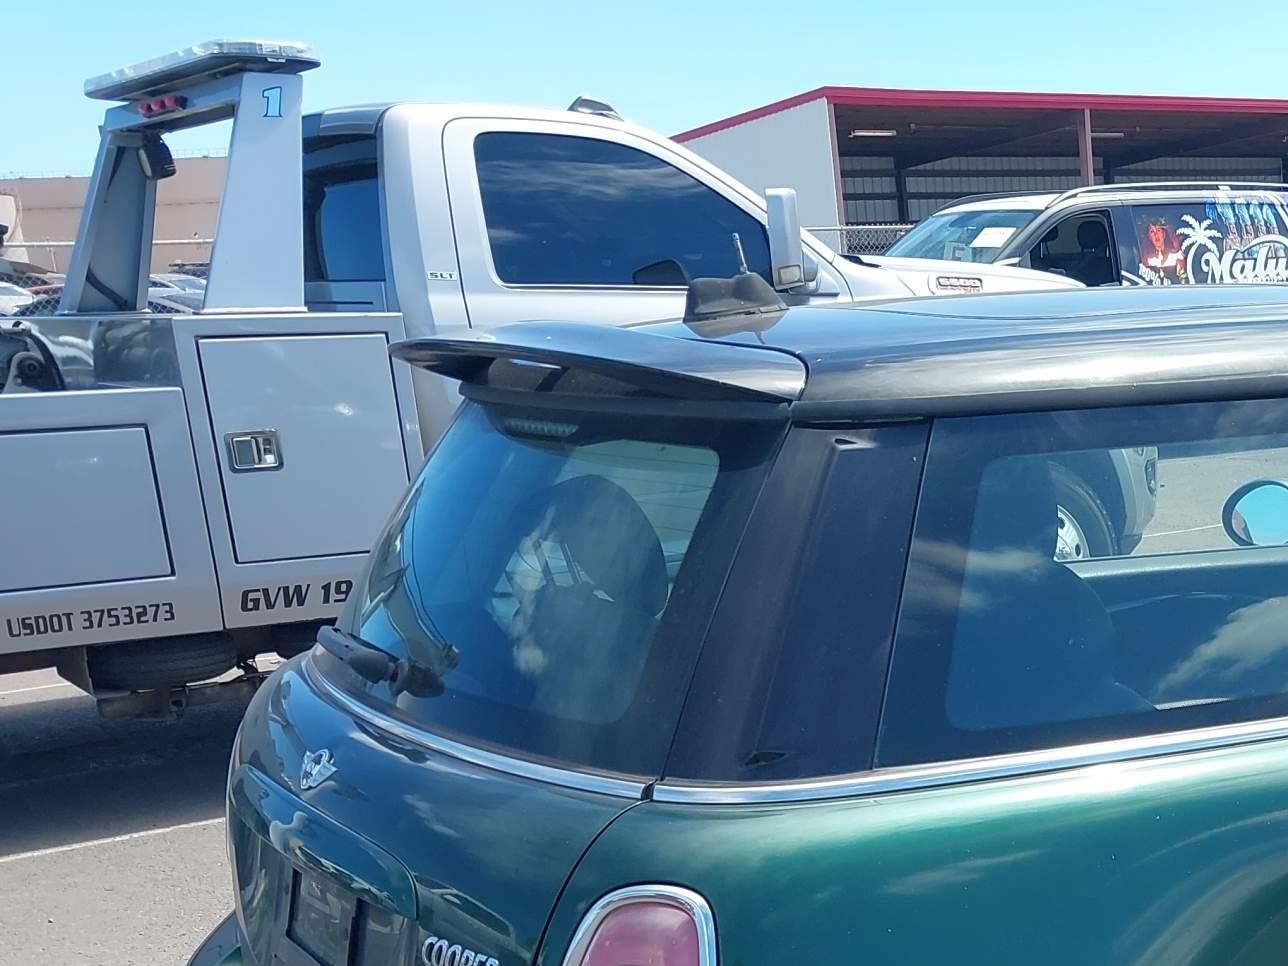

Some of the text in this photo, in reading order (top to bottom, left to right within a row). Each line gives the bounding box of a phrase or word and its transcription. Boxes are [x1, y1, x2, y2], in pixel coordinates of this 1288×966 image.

[262, 86, 283, 117] 1
[240, 579, 353, 613] GVW 19
[6, 602, 175, 638] USDOT 3753273
